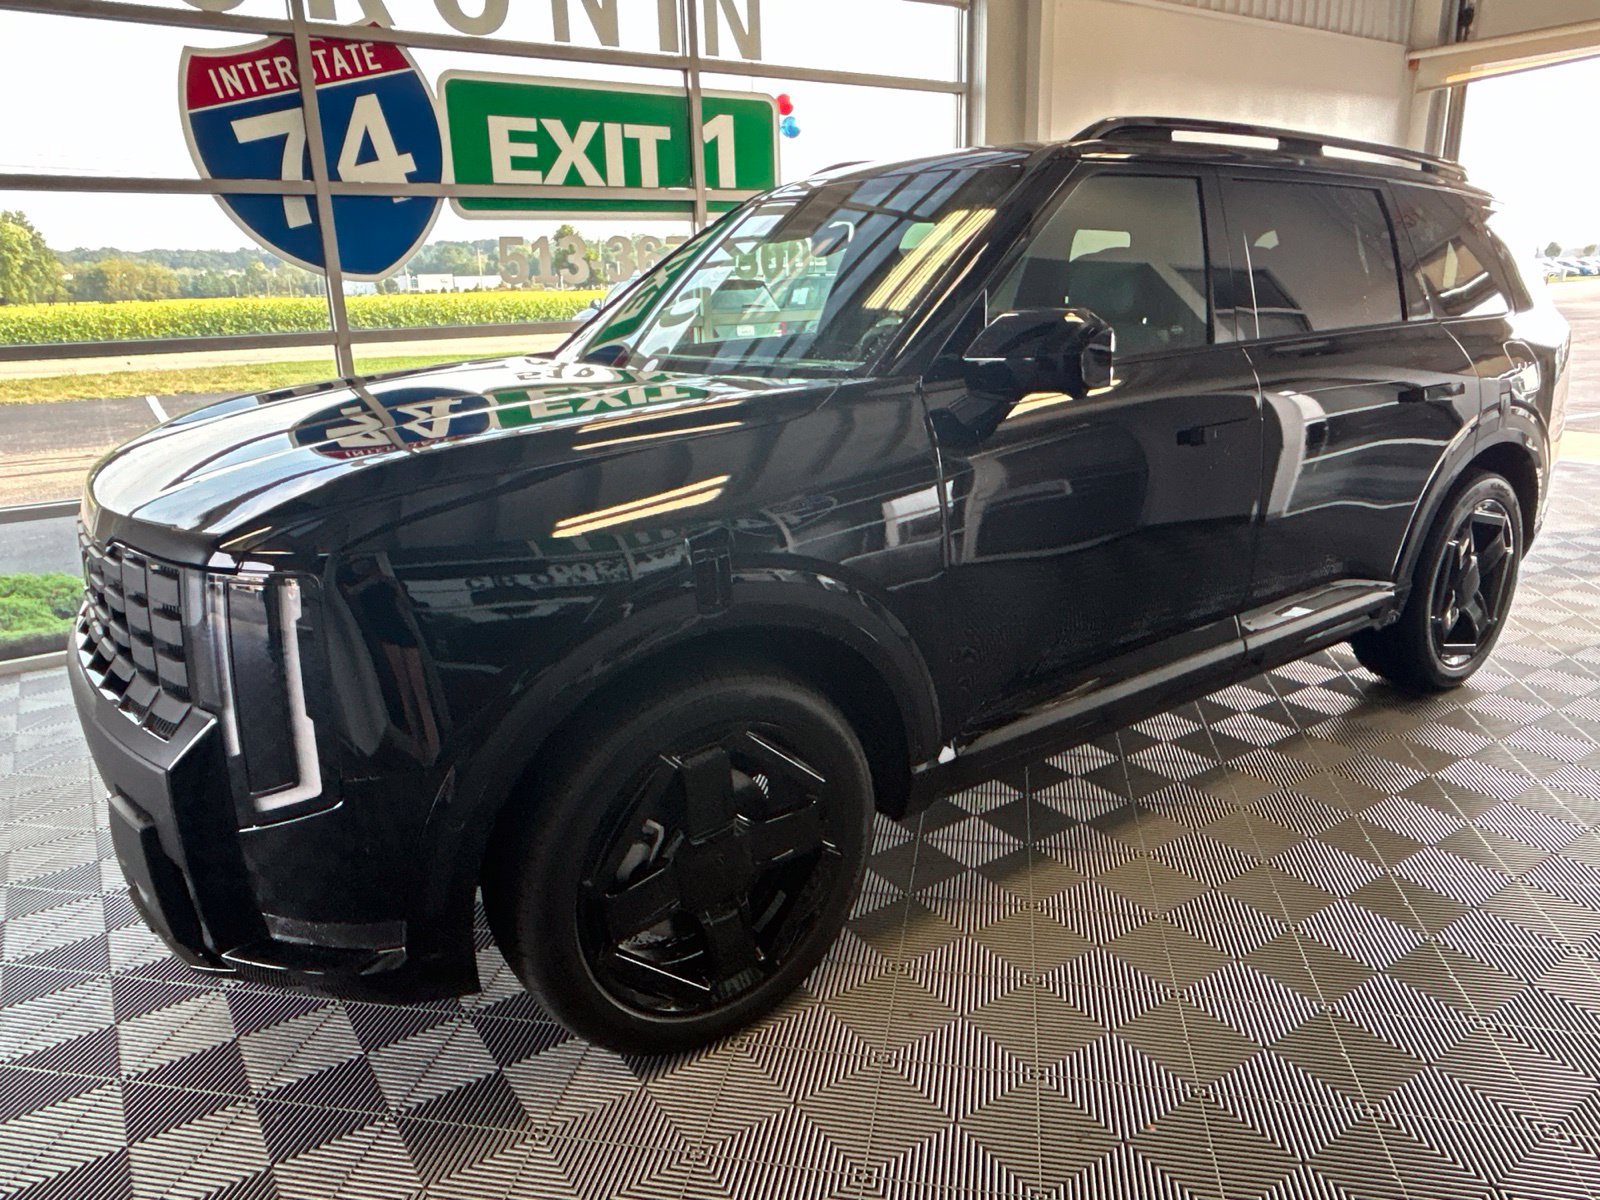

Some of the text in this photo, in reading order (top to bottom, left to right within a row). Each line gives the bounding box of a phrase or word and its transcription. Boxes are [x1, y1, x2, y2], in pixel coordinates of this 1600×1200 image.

[208, 42, 382, 99] INTERTATE
[230, 93, 417, 229] 74
[487, 114, 737, 189] EXIT 1
